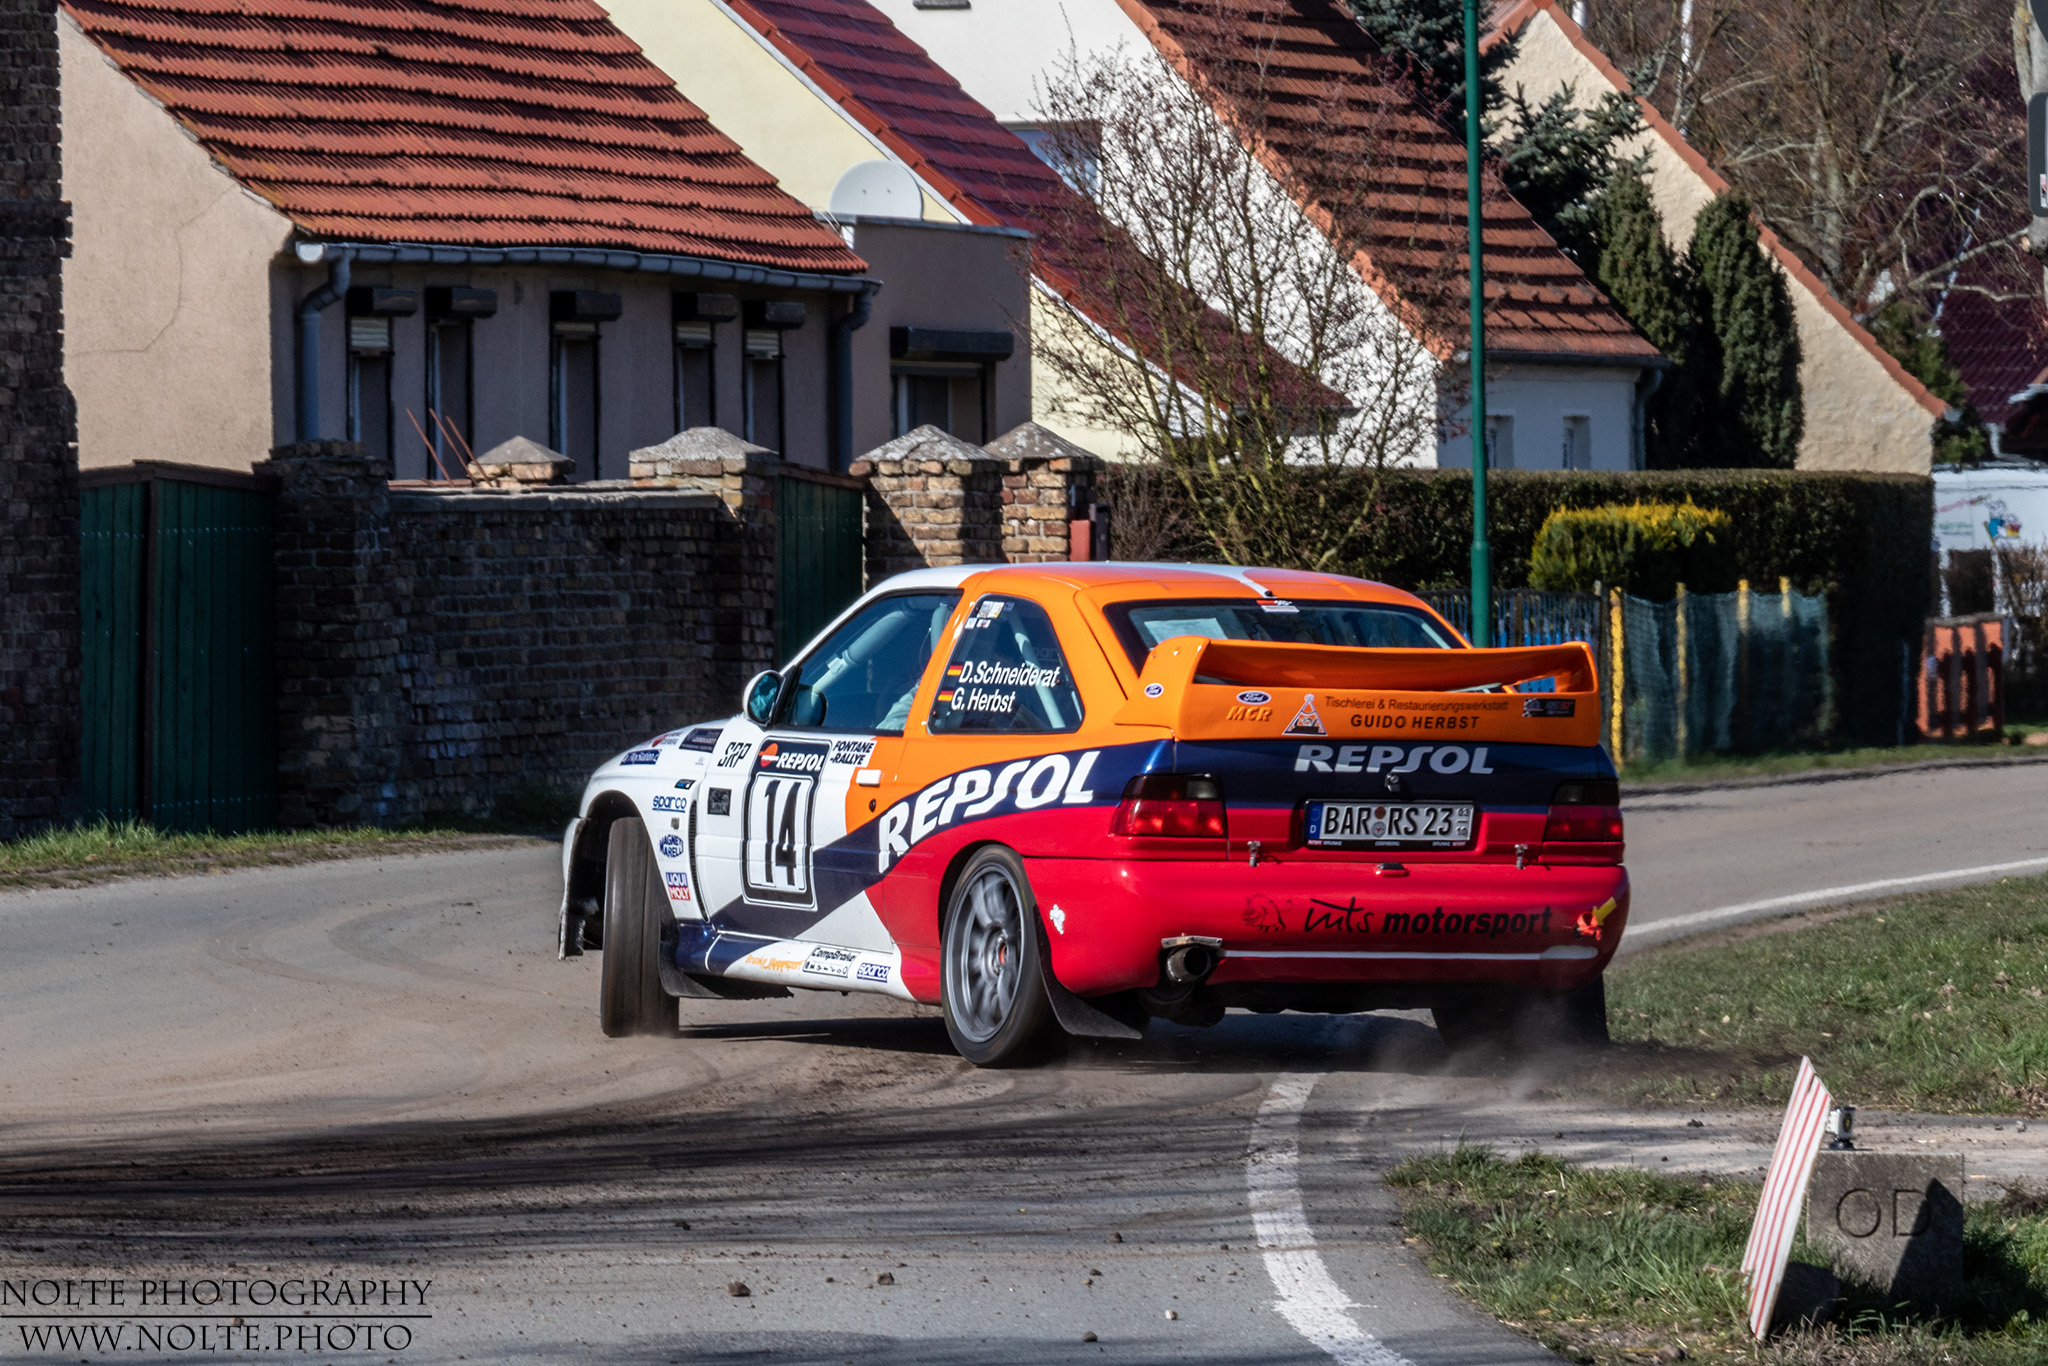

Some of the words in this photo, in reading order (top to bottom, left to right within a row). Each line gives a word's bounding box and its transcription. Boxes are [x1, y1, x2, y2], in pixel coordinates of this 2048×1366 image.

[959, 661, 1060, 688] D.Schneiderat
[951, 687, 966, 711] G.
[967, 687, 1016, 714] Herbst
[1325, 695, 1376, 710] Tischlerei
[1378, 699, 1386, 710] &
[1388, 699, 1509, 713] Restaurierungswerkstatt
[1225, 705, 1273, 722] MCR
[1350, 714, 1407, 729] GUIDO
[1411, 715, 1480, 729] HERBST
[717, 741, 753, 768] SRP
[833, 740, 875, 754] FONTANE
[776, 752, 827, 772] REPSOL
[829, 753, 867, 765] -RALLYE
[1293, 744, 1495, 774] REPSOL
[652, 795, 688, 812] sparco
[877, 750, 1102, 874] REPSOL
[1324, 806, 1371, 835] BAR
[1387, 807, 1418, 836] RS
[1423, 807, 1454, 836] 23
[763, 778, 802, 887] 14
[1309, 826, 1317, 834] D
[667, 873, 687, 887] LIQUI
[669, 886, 690, 900] MOLY
[1381, 905, 1553, 939] motorsport
[811, 947, 857, 962] CompBrake
[857, 963, 890, 979] sparco
